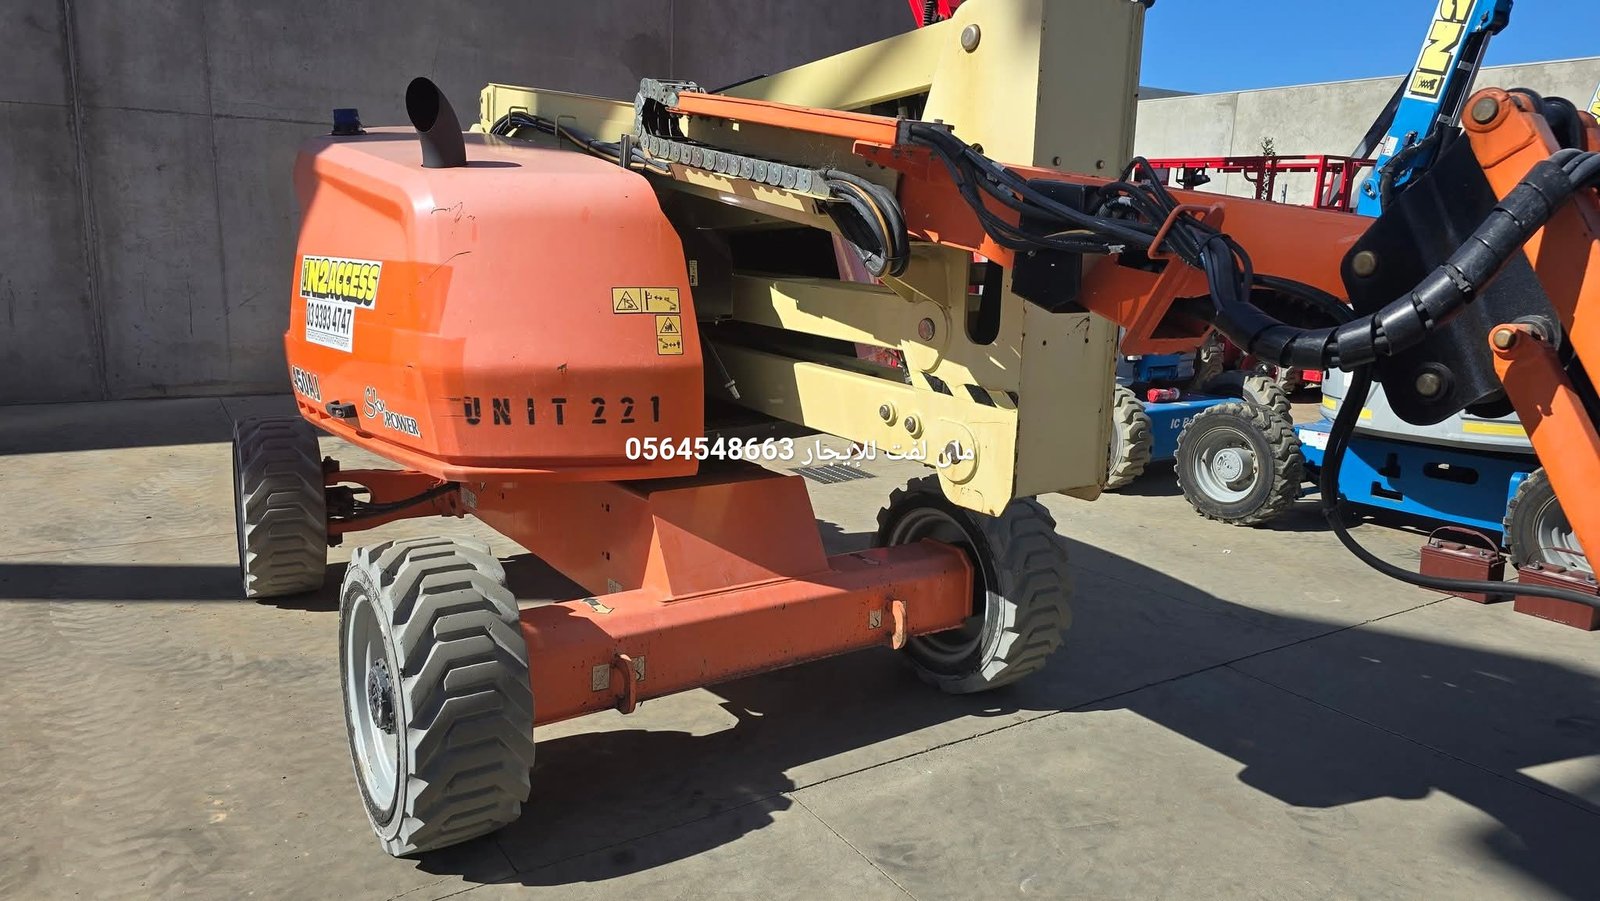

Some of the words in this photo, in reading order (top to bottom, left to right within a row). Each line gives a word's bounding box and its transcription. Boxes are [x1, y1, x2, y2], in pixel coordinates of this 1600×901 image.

[302, 257, 380, 306] IN2ACCESS
[307, 302, 315, 327] 03
[315, 304, 331, 331] 9393
[332, 306, 352, 335] 4747
[384, 411, 420, 436] POWER
[463, 396, 567, 426] UNIT
[591, 396, 661, 425] 221
